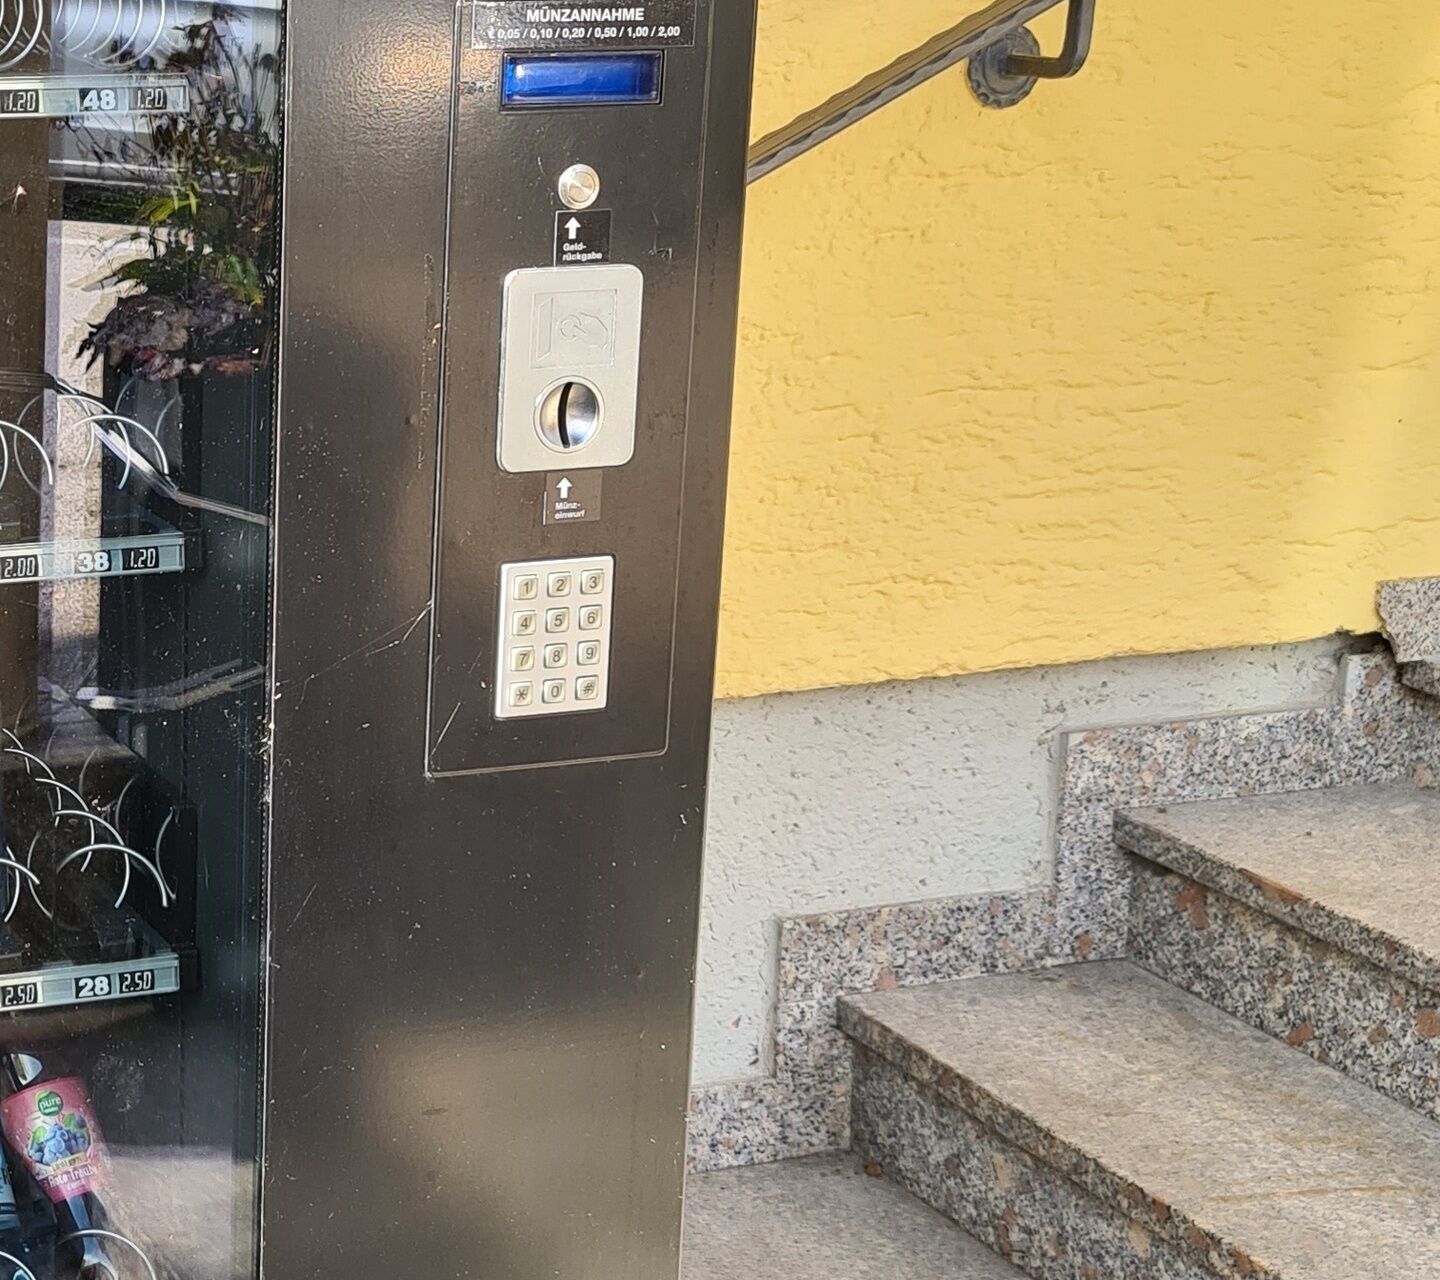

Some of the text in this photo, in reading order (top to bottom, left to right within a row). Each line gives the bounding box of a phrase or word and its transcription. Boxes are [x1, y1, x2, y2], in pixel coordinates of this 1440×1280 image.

[526, 7, 645, 22] MÜNZANNAHME
[498, 27, 520, 39] 0,05
[530, 27, 553, 39] 0,10
[562, 27, 585, 39] 0,20
[594, 27, 617, 39] 0,50
[627, 26, 649, 38] 1,00
[658, 26, 680, 37] 2,00
[83, 88, 164, 110] 48 1.20
[563, 242, 587, 251] Geld-
[562, 251, 602, 262] rückgabe
[555, 501, 581, 511] Münz-
[554, 509, 585, 520] einwurf
[4, 557, 35, 578] 2.00
[77, 549, 155, 572] 38 1.20
[79, 971, 152, 996] 28 2.50
[4, 985, 35, 1006] 2.50
[40, 1097, 62, 1111] pure
